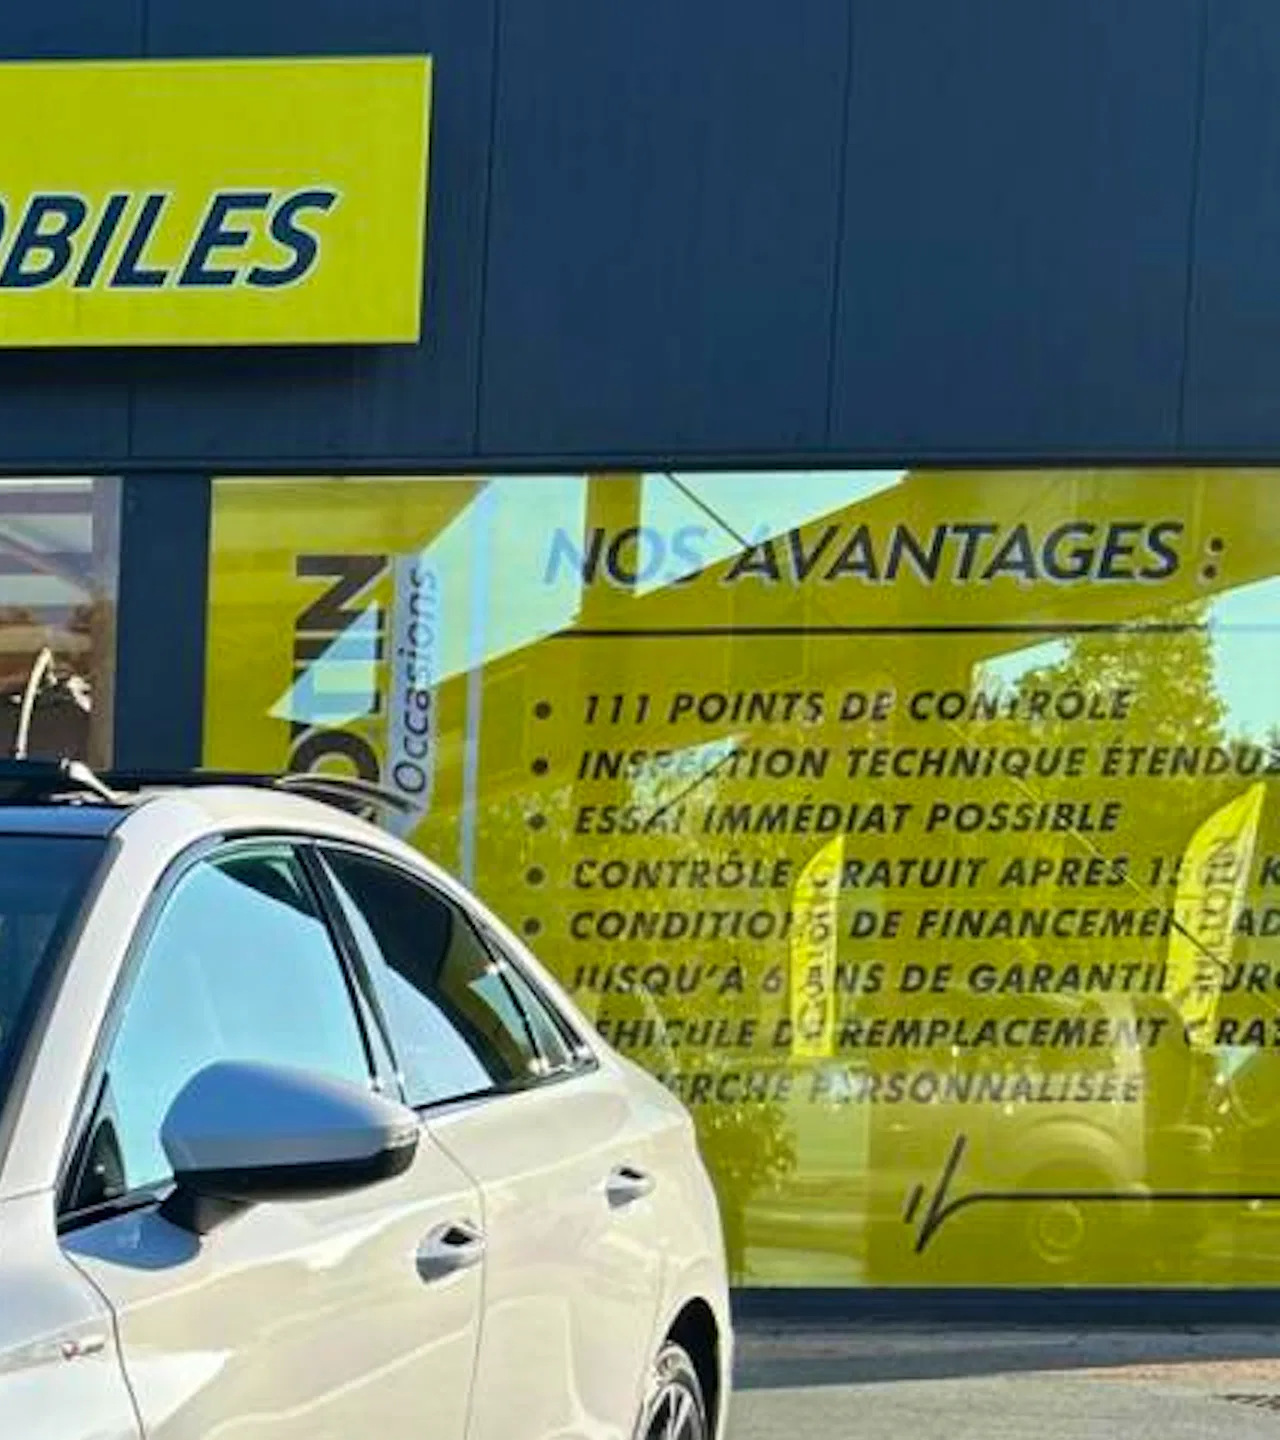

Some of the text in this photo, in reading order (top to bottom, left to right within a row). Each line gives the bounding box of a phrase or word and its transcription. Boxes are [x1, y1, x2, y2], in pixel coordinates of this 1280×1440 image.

[543, 525, 708, 584] NOS
[725, 521, 1184, 583] AVANTAGES
[392, 566, 437, 796] Occasions
[585, 681, 1131, 724] 111 POINTS DE CONTRÔLE
[578, 749, 830, 781] INSPECTION
[848, 747, 1087, 778] TECHNIQUE
[574, 794, 1122, 835] ESSAI IMMÉDIAT POSSIBLE
[573, 850, 794, 890] CONTRÔLE
[838, 858, 987, 889] RATUIT
[851, 911, 902, 939] DE
[917, 909, 1175, 938] FINANCEME
[762, 966, 782, 993] 6
[834, 963, 885, 993] NS
[899, 964, 952, 992] DE
[595, 1011, 757, 1048] ÉHICULE
[840, 1018, 1169, 1048] REMPLACEMENT
